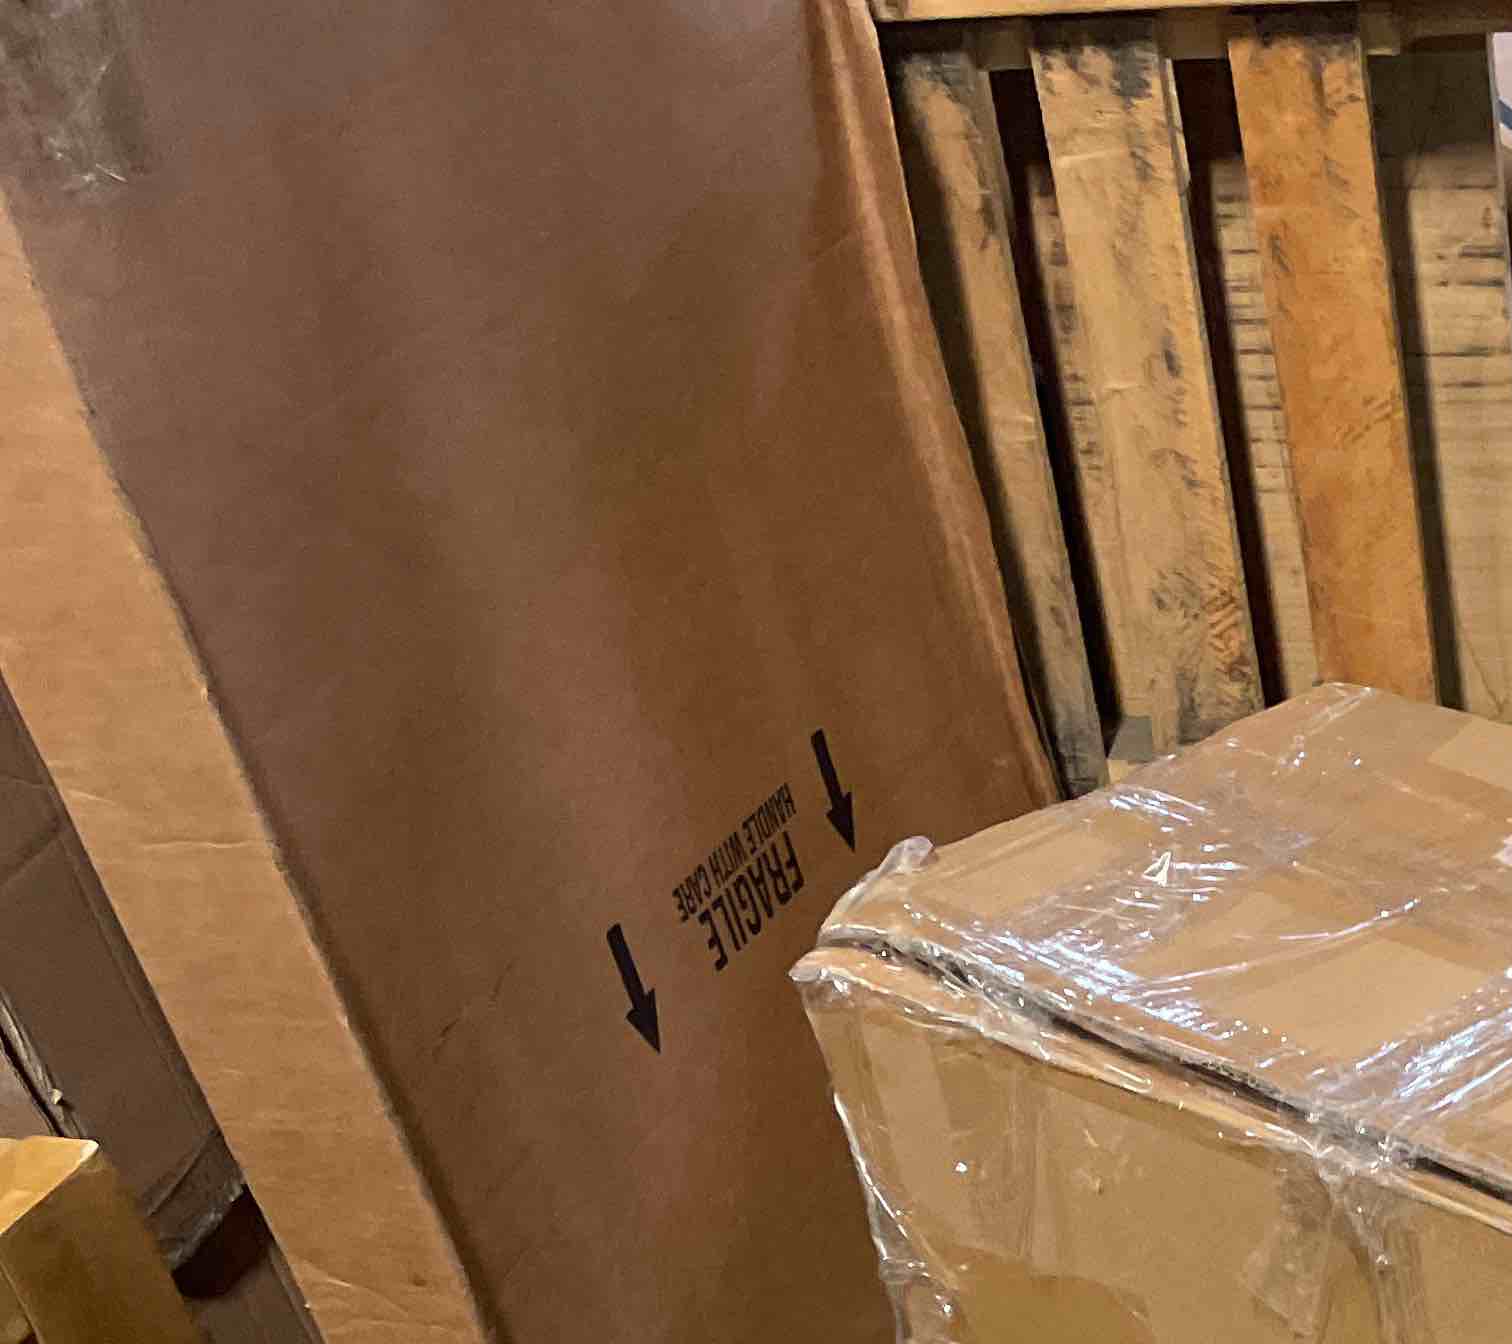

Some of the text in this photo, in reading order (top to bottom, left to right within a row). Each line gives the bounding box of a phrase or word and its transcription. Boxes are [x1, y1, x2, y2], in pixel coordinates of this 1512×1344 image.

[671, 782, 797, 923] HANDLE WITH CARE
[698, 830, 805, 972] FRAGILE
